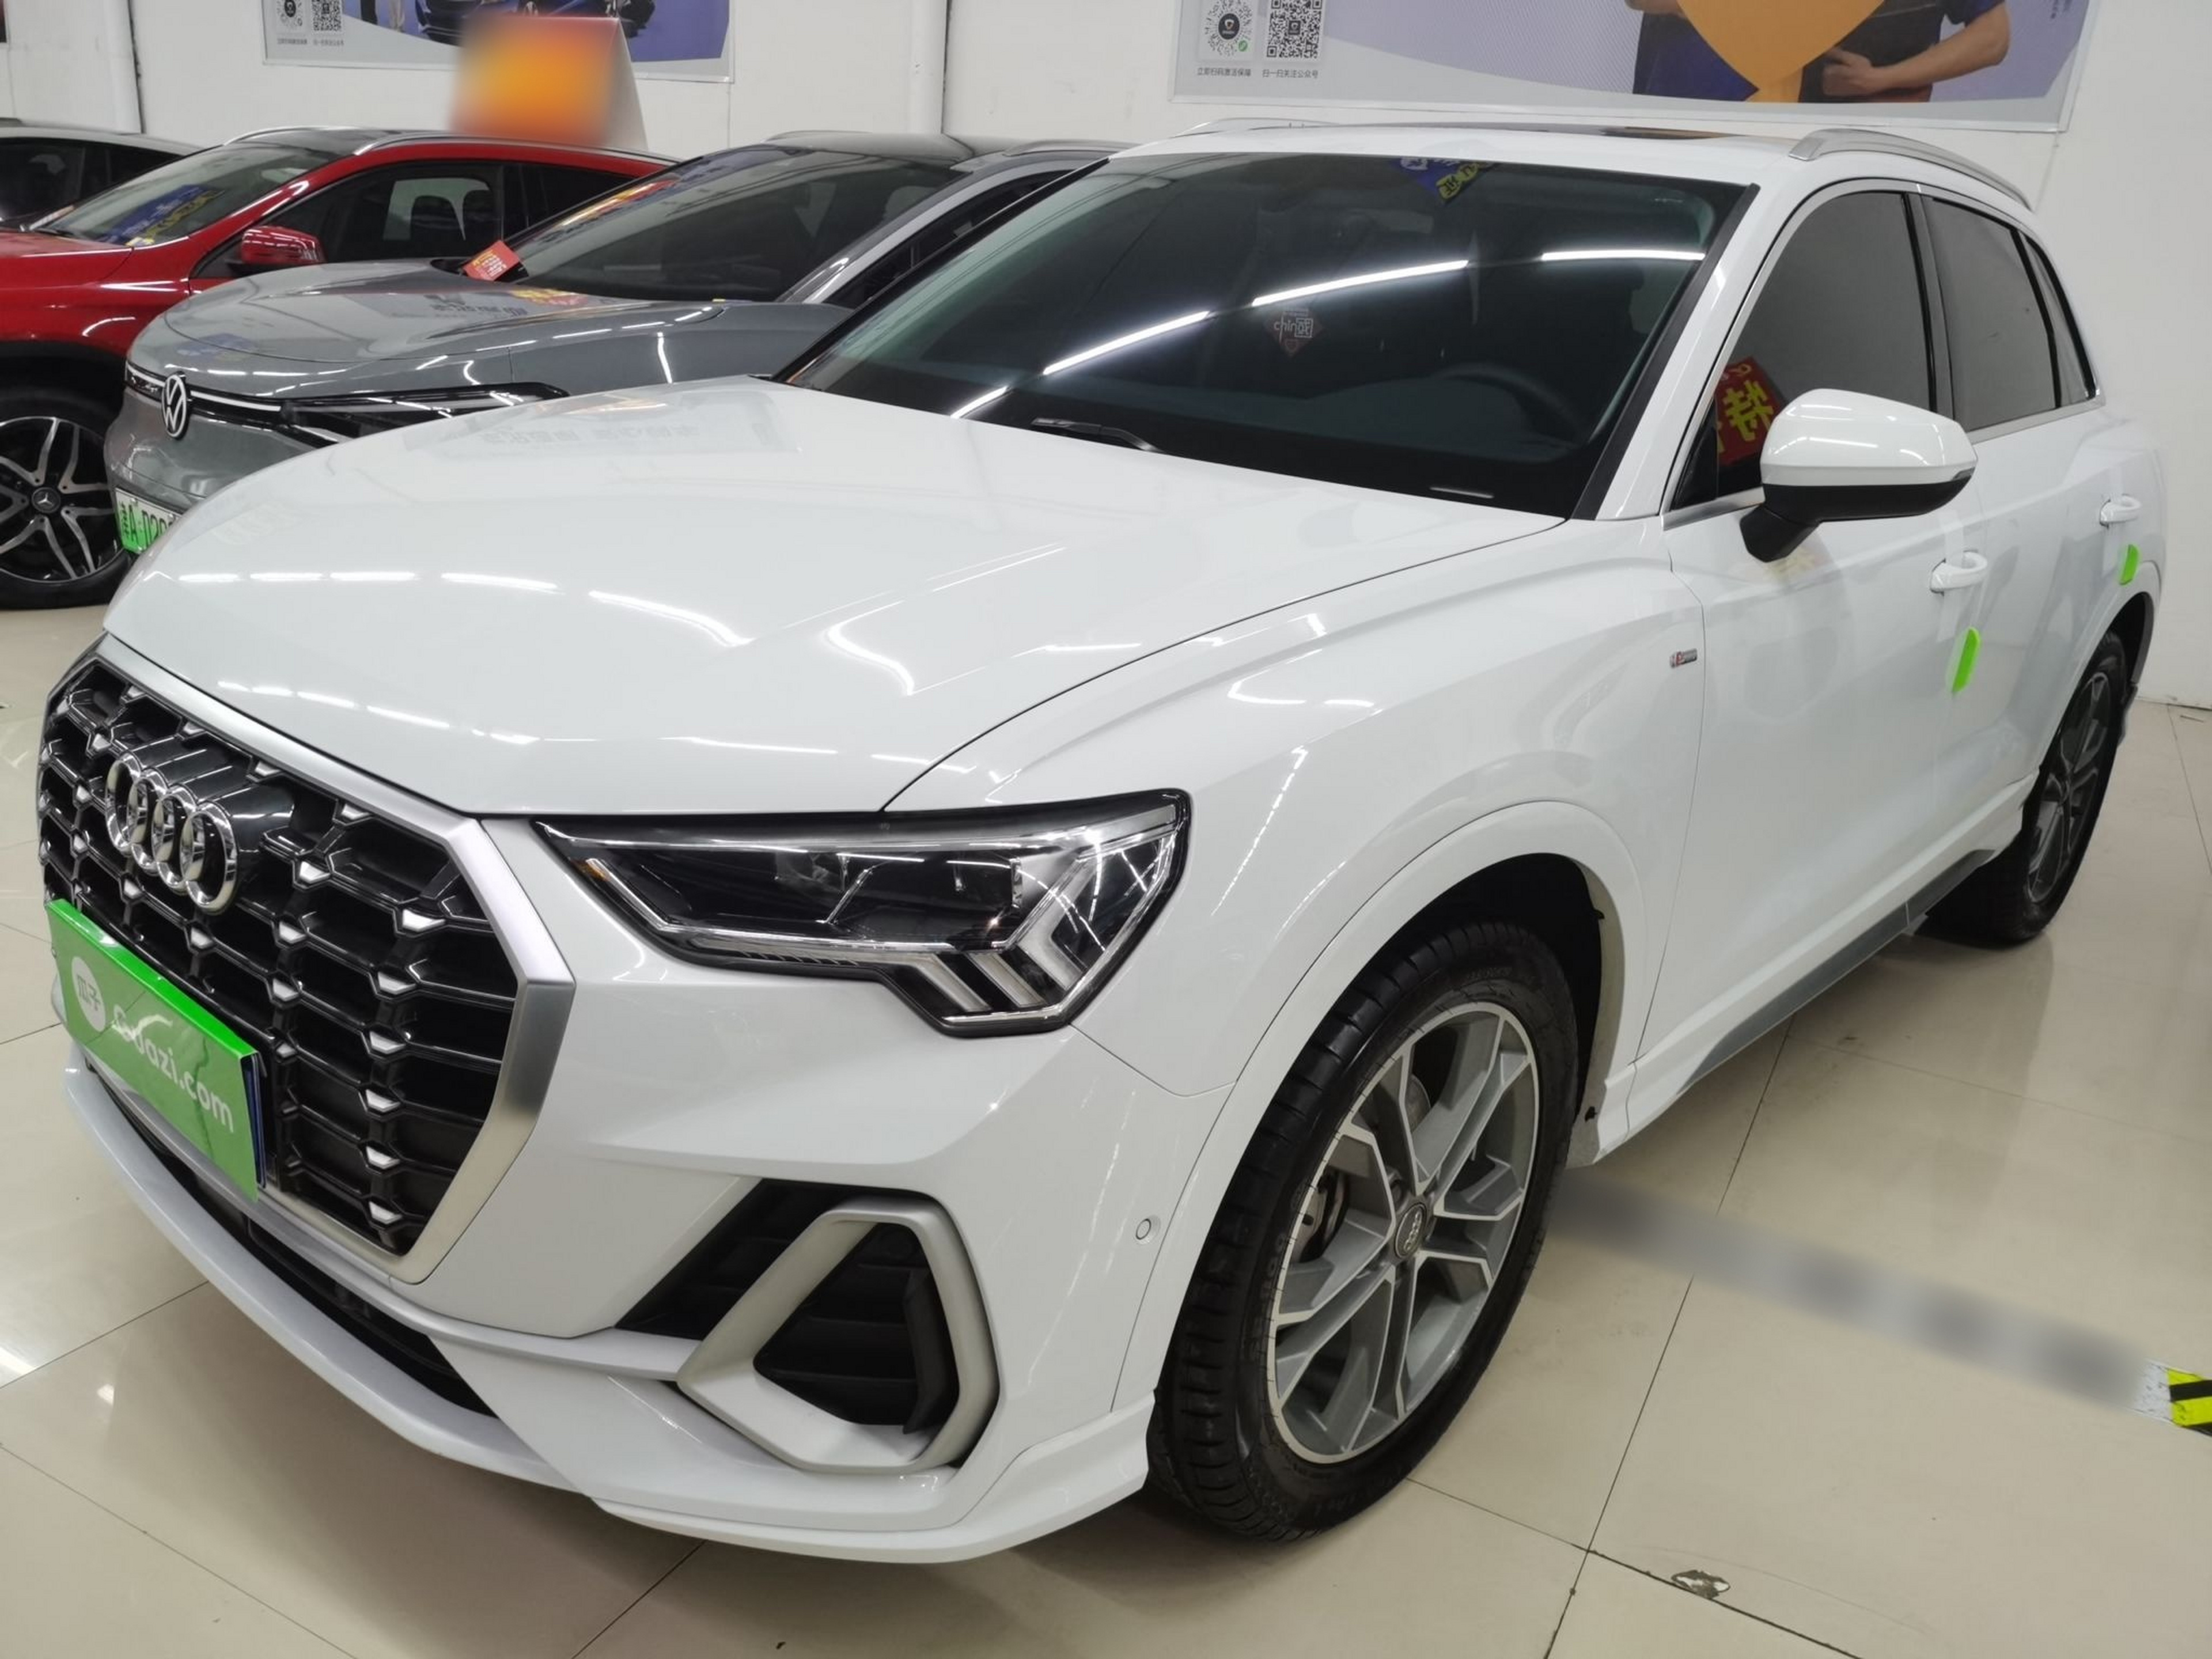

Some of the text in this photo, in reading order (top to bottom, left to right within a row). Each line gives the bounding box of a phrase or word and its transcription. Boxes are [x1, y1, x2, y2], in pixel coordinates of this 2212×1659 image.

[1262, 69, 1319, 78] 扫一扫关注公众号
[76, 972, 101, 1012] 瓜子
